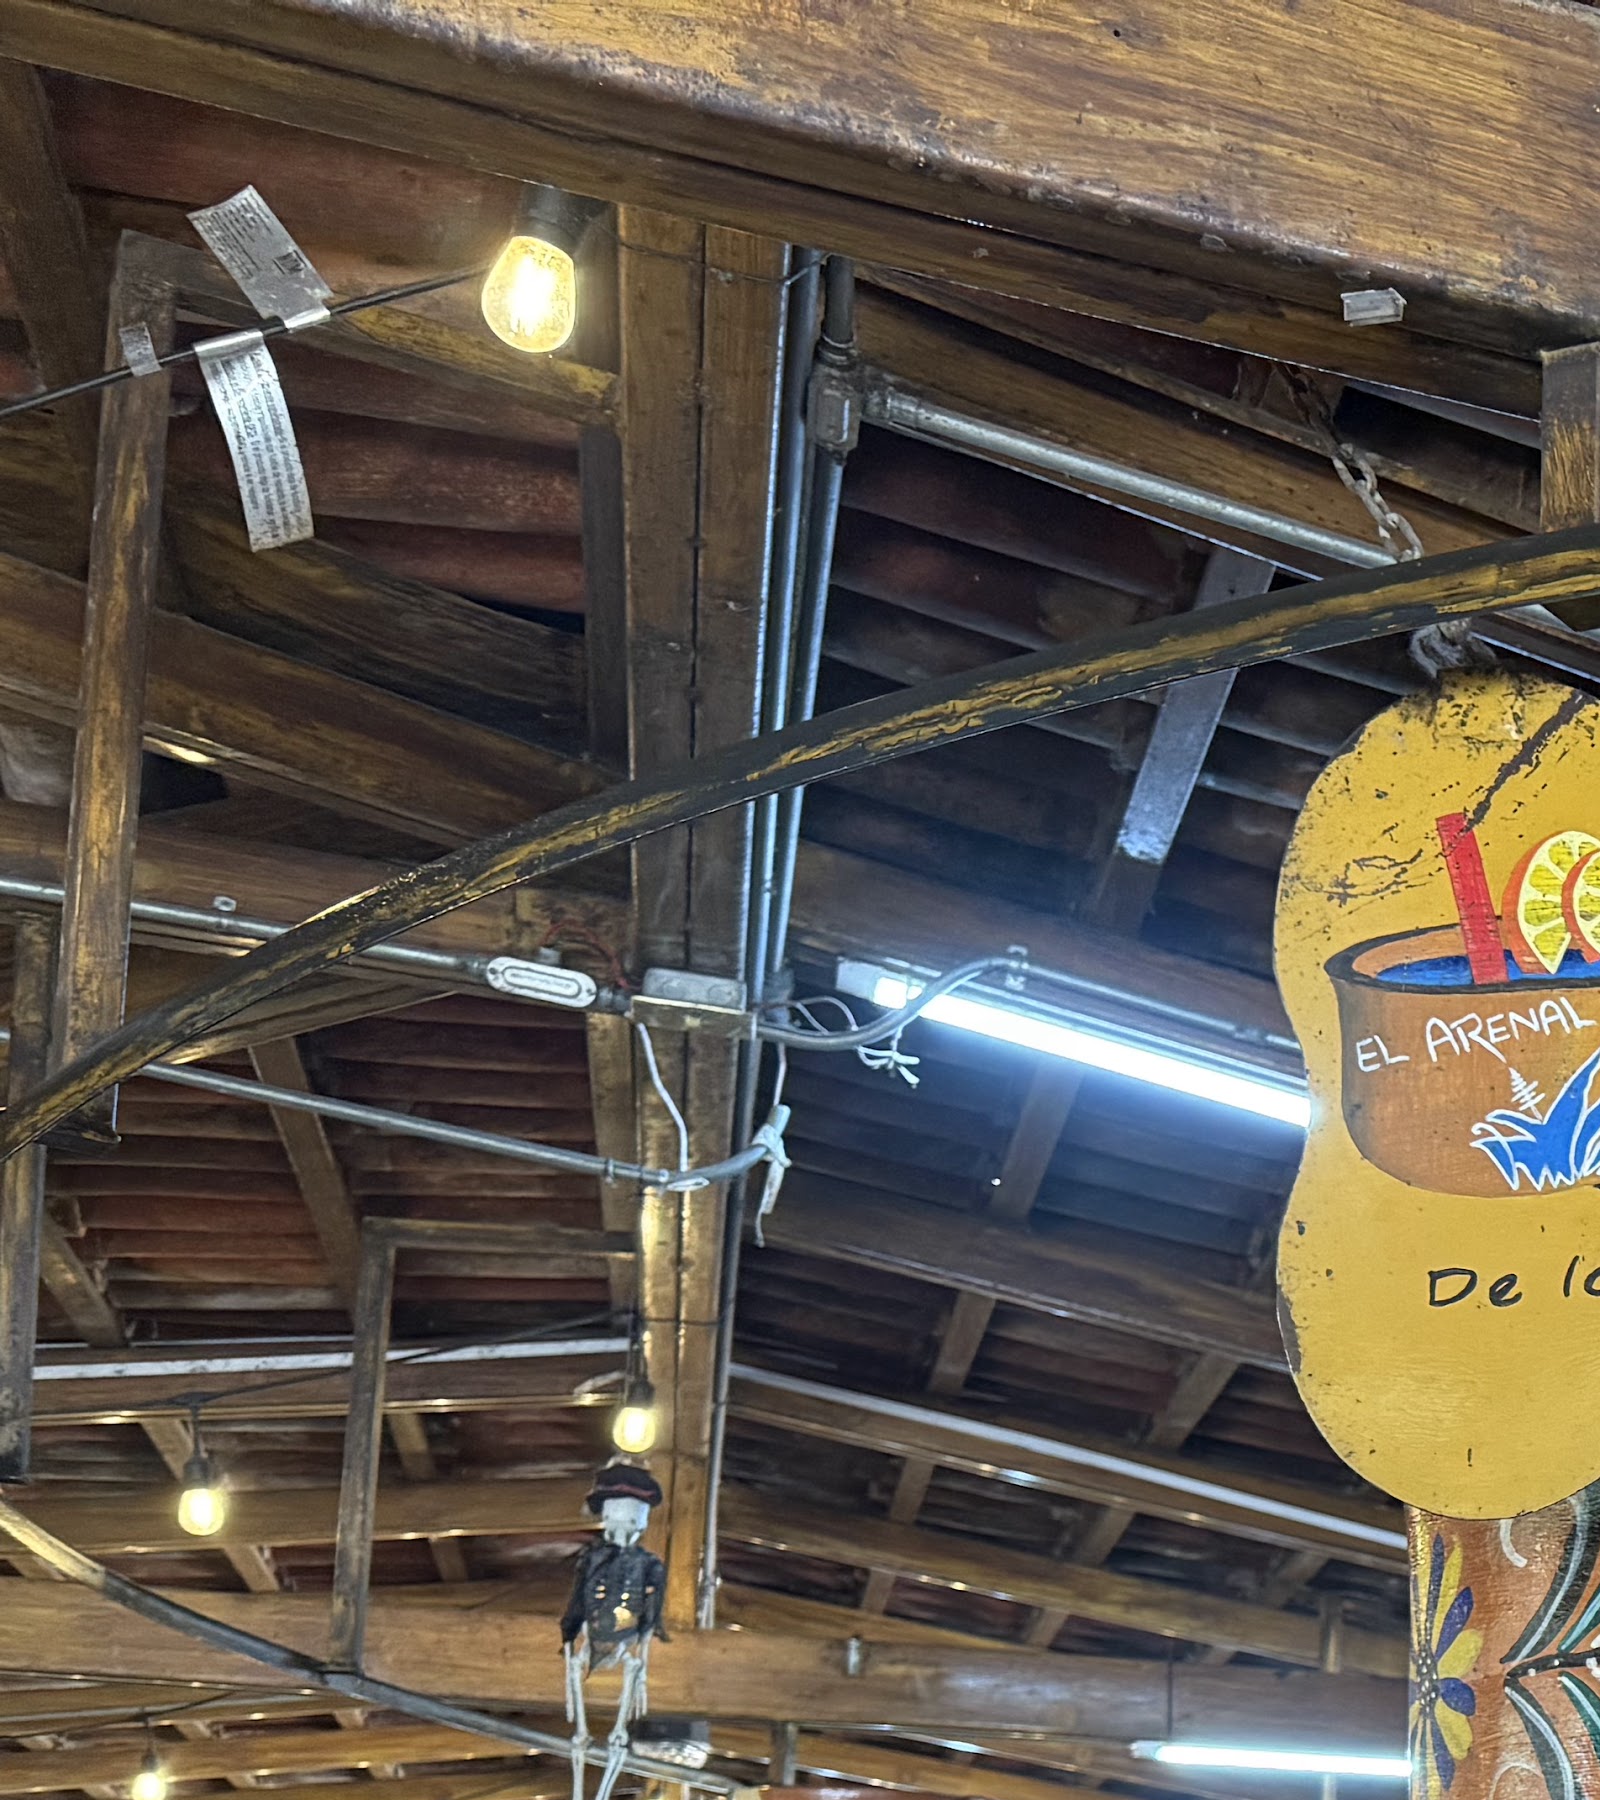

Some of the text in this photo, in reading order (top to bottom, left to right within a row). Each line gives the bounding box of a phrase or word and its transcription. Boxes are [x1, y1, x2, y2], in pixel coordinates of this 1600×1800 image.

[1355, 996, 1597, 1073] EL ARENAL
[1428, 1265, 1523, 1309] De
